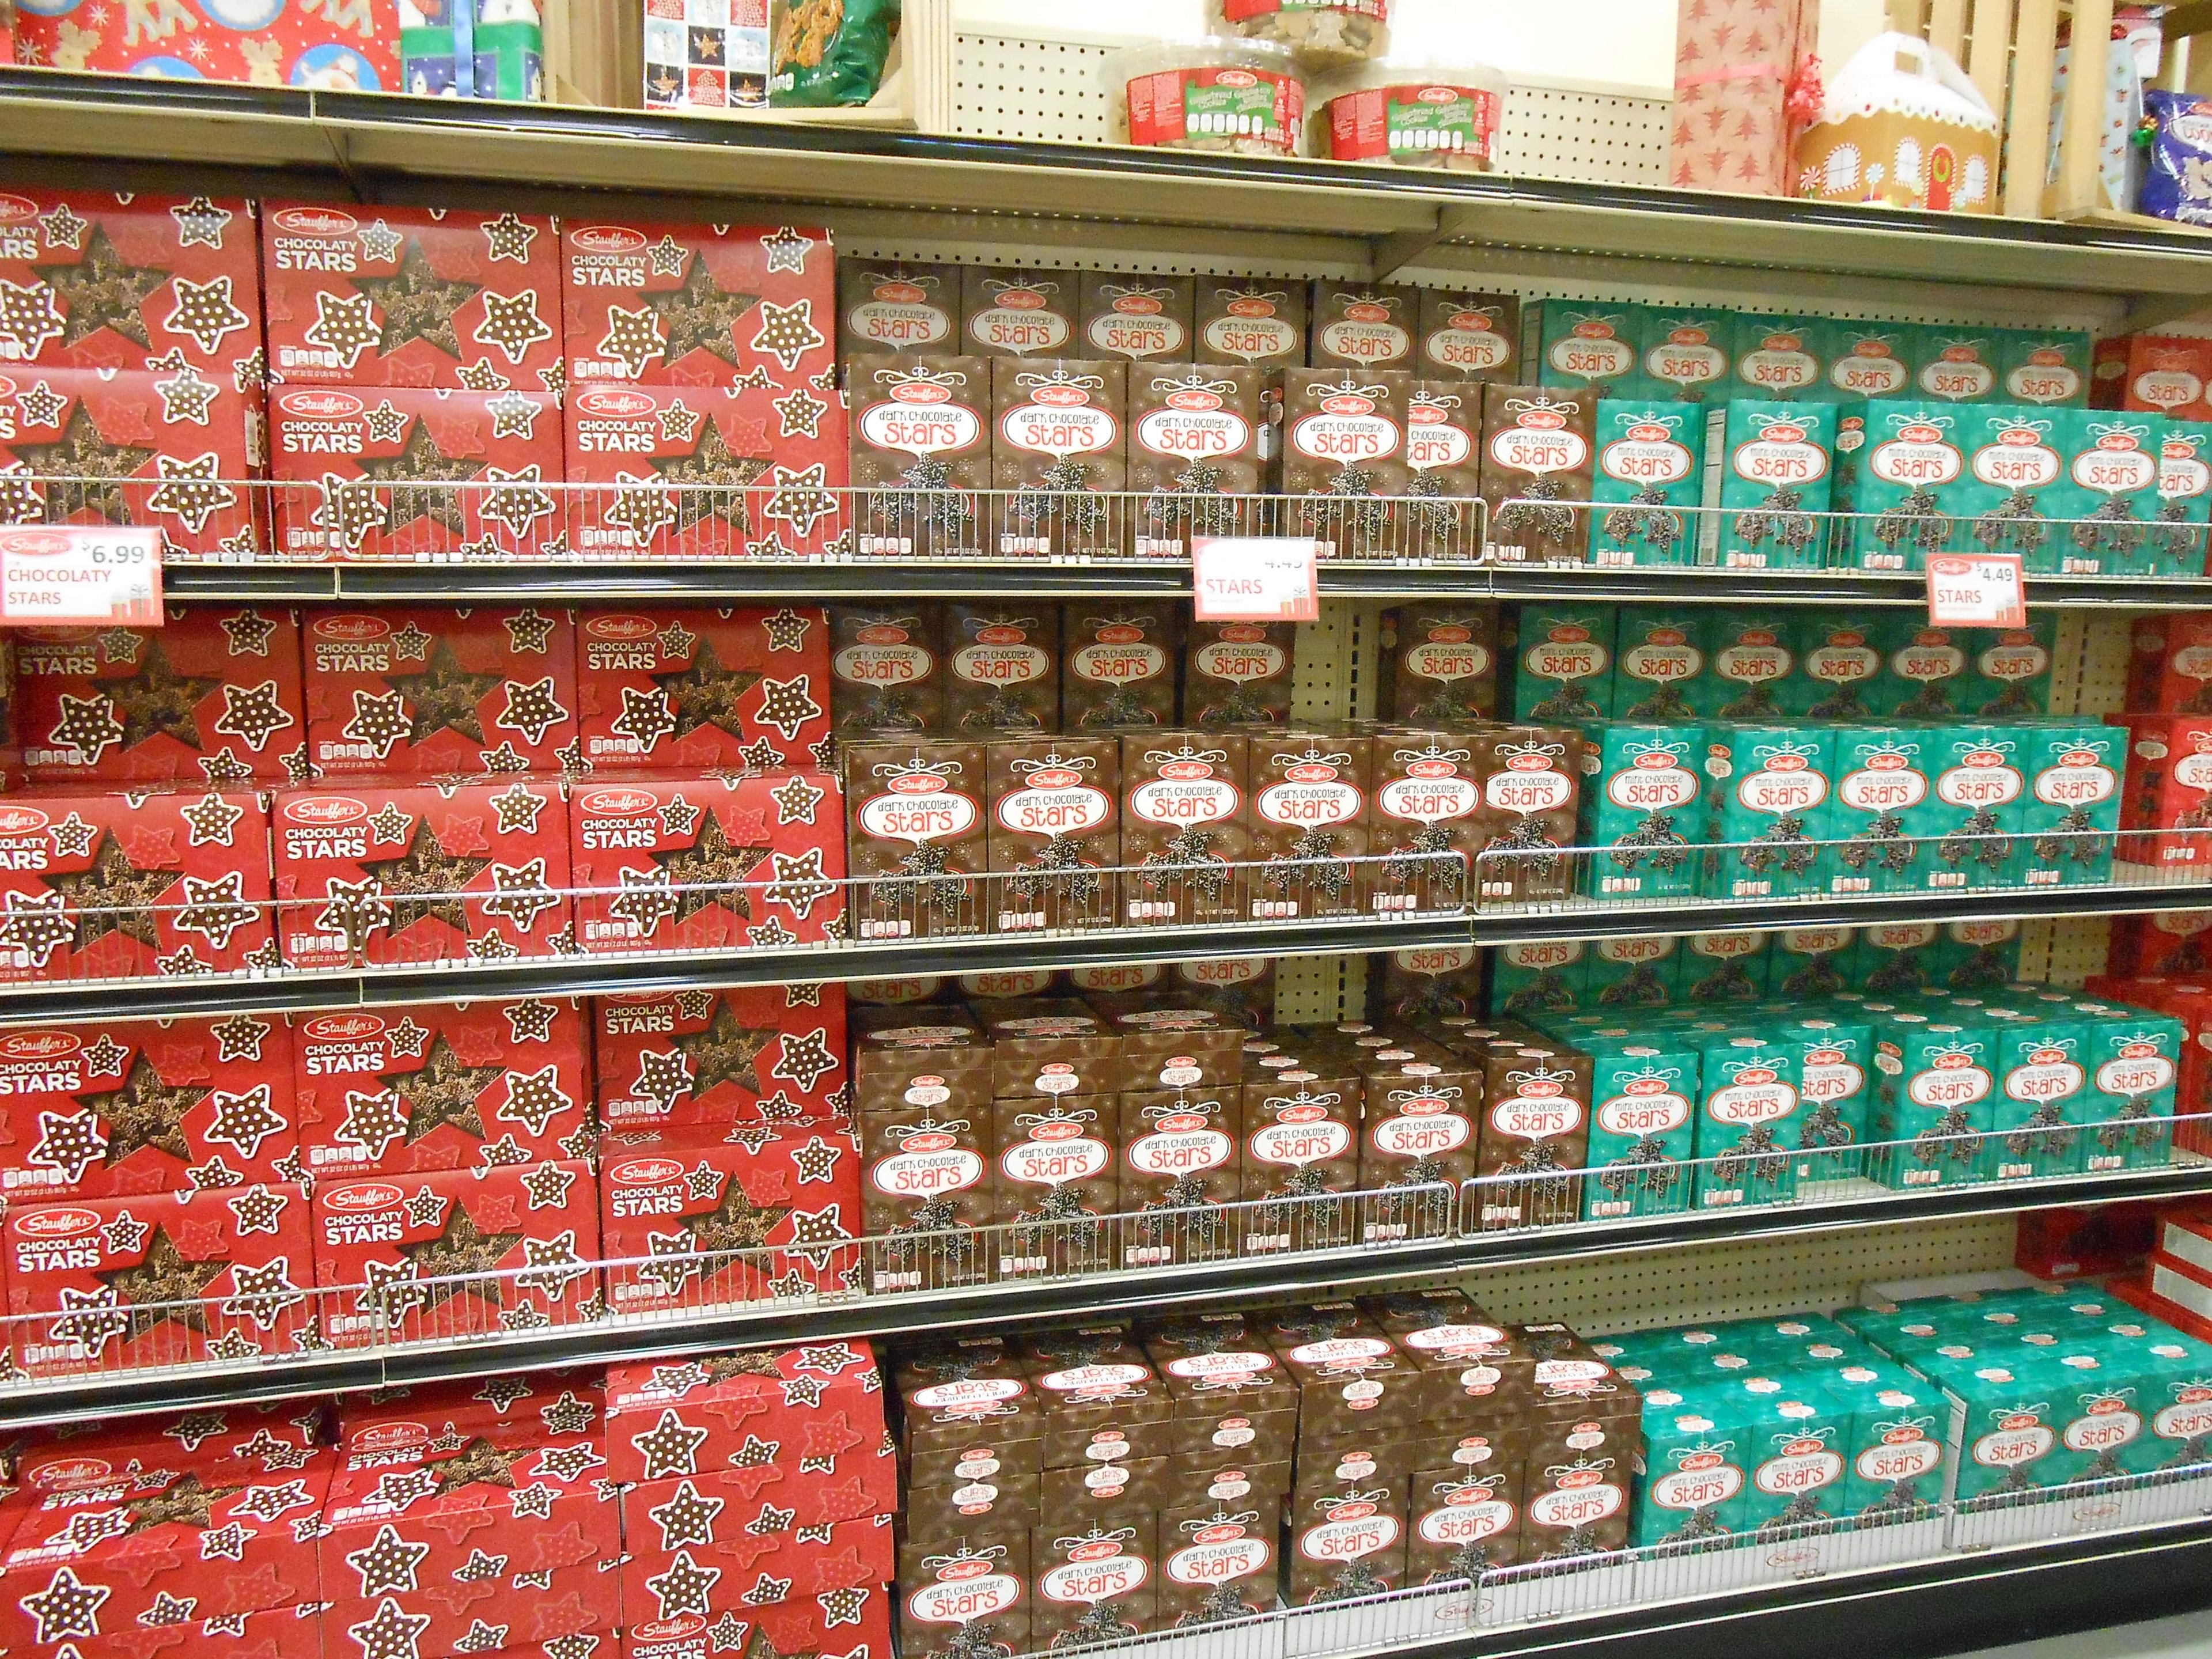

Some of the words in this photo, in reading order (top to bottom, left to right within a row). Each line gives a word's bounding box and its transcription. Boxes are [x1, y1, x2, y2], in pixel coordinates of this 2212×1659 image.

[275, 238, 357, 251] CHOCOLATY
[276, 250, 357, 272] STARS
[572, 256, 646, 267] CHOCOLATY
[573, 267, 645, 286] STARS
[578, 421, 656, 431] CHOCOLATY
[880, 411, 906, 421] dark
[909, 411, 961, 422] chocolate
[1021, 413, 1046, 423] dark
[1049, 414, 1099, 425] chocolate
[1156, 418, 1180, 427] dark
[1183, 418, 1232, 429] chocolate
[282, 422, 363, 433] CHOCOLATY
[885, 423, 957, 445] stars
[1026, 425, 1094, 446] stars
[1310, 422, 1335, 431] dark
[1337, 423, 1383, 432] chocolate
[1411, 431, 1455, 441] chocolate
[283, 434, 362, 453] STARS
[579, 433, 655, 452] STARS
[1160, 429, 1226, 450] stars
[1315, 433, 1378, 454] stars
[1507, 435, 1529, 444] dark
[1531, 436, 1573, 446] chocolate
[1511, 446, 1568, 466] stars
[1620, 457, 1673, 476] stars
[1753, 458, 1808, 478] stars
[1893, 458, 1943, 478] stars
[1991, 462, 2040, 481] stars
[2092, 467, 2138, 485] stars
[9, 569, 111, 582] CHOCOLATY
[1206, 578, 1263, 594] STARS
[9, 592, 61, 604] STARS
[1937, 589, 1982, 603] STARS
[18, 645, 97, 656] CHOCOLATY
[315, 643, 390, 653] CHOCOLATY
[587, 643, 657, 652] CHOCOLATY
[23, 657, 97, 675] STARS
[317, 655, 389, 672] STARS
[589, 653, 656, 669] STARS
[972, 660, 1031, 678] stars
[1148, 788, 1172, 797] dark
[1175, 786, 1222, 796] chocolate
[1396, 785, 1419, 794] dark
[1421, 785, 1464, 794] chocolate
[1496, 778, 1517, 786] dark
[1519, 778, 1559, 786] chocolate
[1956, 782, 2006, 800] stars
[2051, 781, 2099, 799] stars
[1016, 797, 1041, 806] dark
[1043, 794, 1092, 805] chocolate
[1275, 790, 1298, 798] dark
[1301, 789, 1346, 798] chocolate
[1499, 787, 1554, 805] stars
[1627, 784, 1679, 802] stars
[1757, 786, 1809, 806] stars
[1859, 786, 1908, 804] stars
[878, 802, 904, 812] dark
[907, 800, 958, 810] chocolate
[1153, 797, 1217, 817] stars
[1279, 800, 1340, 819] stars
[1399, 795, 1459, 814] stars
[582, 818, 657, 830] CHOCOLATY
[884, 811, 953, 833] stars
[1021, 805, 1087, 827] stars
[286, 827, 368, 839] CHOCOLATY
[584, 830, 656, 849] STARS
[287, 839, 366, 859] STARS
[605, 1005, 675, 1017] CHOCOLATY
[607, 1016, 673, 1034] STARS
[305, 1041, 385, 1055] CHOCOLATY
[307, 1053, 384, 1074] STARS
[0, 1072, 81, 1094] STARS
[2022, 1077, 2067, 1097] stars
[2113, 1071, 2154, 1089] stars
[1926, 1082, 1974, 1101] stars
[1507, 1104, 1528, 1112] dark
[1529, 1103, 1569, 1112] chocolate
[1728, 1099, 1779, 1119] stars
[1389, 1123, 1412, 1131] dark
[1414, 1120, 1456, 1130] chocolate
[1509, 1113, 1564, 1131] stars
[1618, 1109, 1670, 1129] stars
[1145, 1140, 1169, 1149] dark
[1171, 1136, 1216, 1147] chocolate
[1267, 1131, 1290, 1139] dark
[1292, 1127, 1335, 1138] chocolate
[1393, 1129, 1450, 1150] stars
[1020, 1149, 1043, 1158] dark
[1046, 1145, 1093, 1156] chocolate
[1150, 1146, 1211, 1168] stars
[1271, 1137, 1331, 1158] stars
[890, 1161, 915, 1170] dark
[918, 1155, 966, 1168] chocolate
[1024, 1154, 1088, 1177] stars
[896, 1166, 962, 1190] stars
[612, 1185, 683, 1199] CHOCOLATY
[613, 1196, 683, 1217] STARS
[325, 1211, 403, 1226] CHOCOLATY
[327, 1223, 403, 1245] STARS
[16, 1237, 101, 1253] CHOCOLATY
[18, 1249, 100, 1272] STARS
[2080, 1427, 2126, 1447] stars
[1990, 1441, 2037, 1461] stars
[347, 1452, 423, 1471] STARS
[1874, 1456, 1923, 1476] stars
[1774, 1467, 1824, 1490] stars
[40, 1490, 125, 1510] STARS
[1671, 1480, 1725, 1504] stars
[1550, 1500, 1604, 1521] stars
[1438, 1517, 1495, 1539] stars
[1183, 1552, 1207, 1561] dark
[1209, 1542, 1254, 1559] chocolate
[1321, 1532, 1380, 1556] stars
[1188, 1555, 1249, 1580] stars
[1063, 1573, 1127, 1597] stars
[933, 1590, 998, 1618] stars
[632, 1638, 707, 1657] CHOCOLATY
